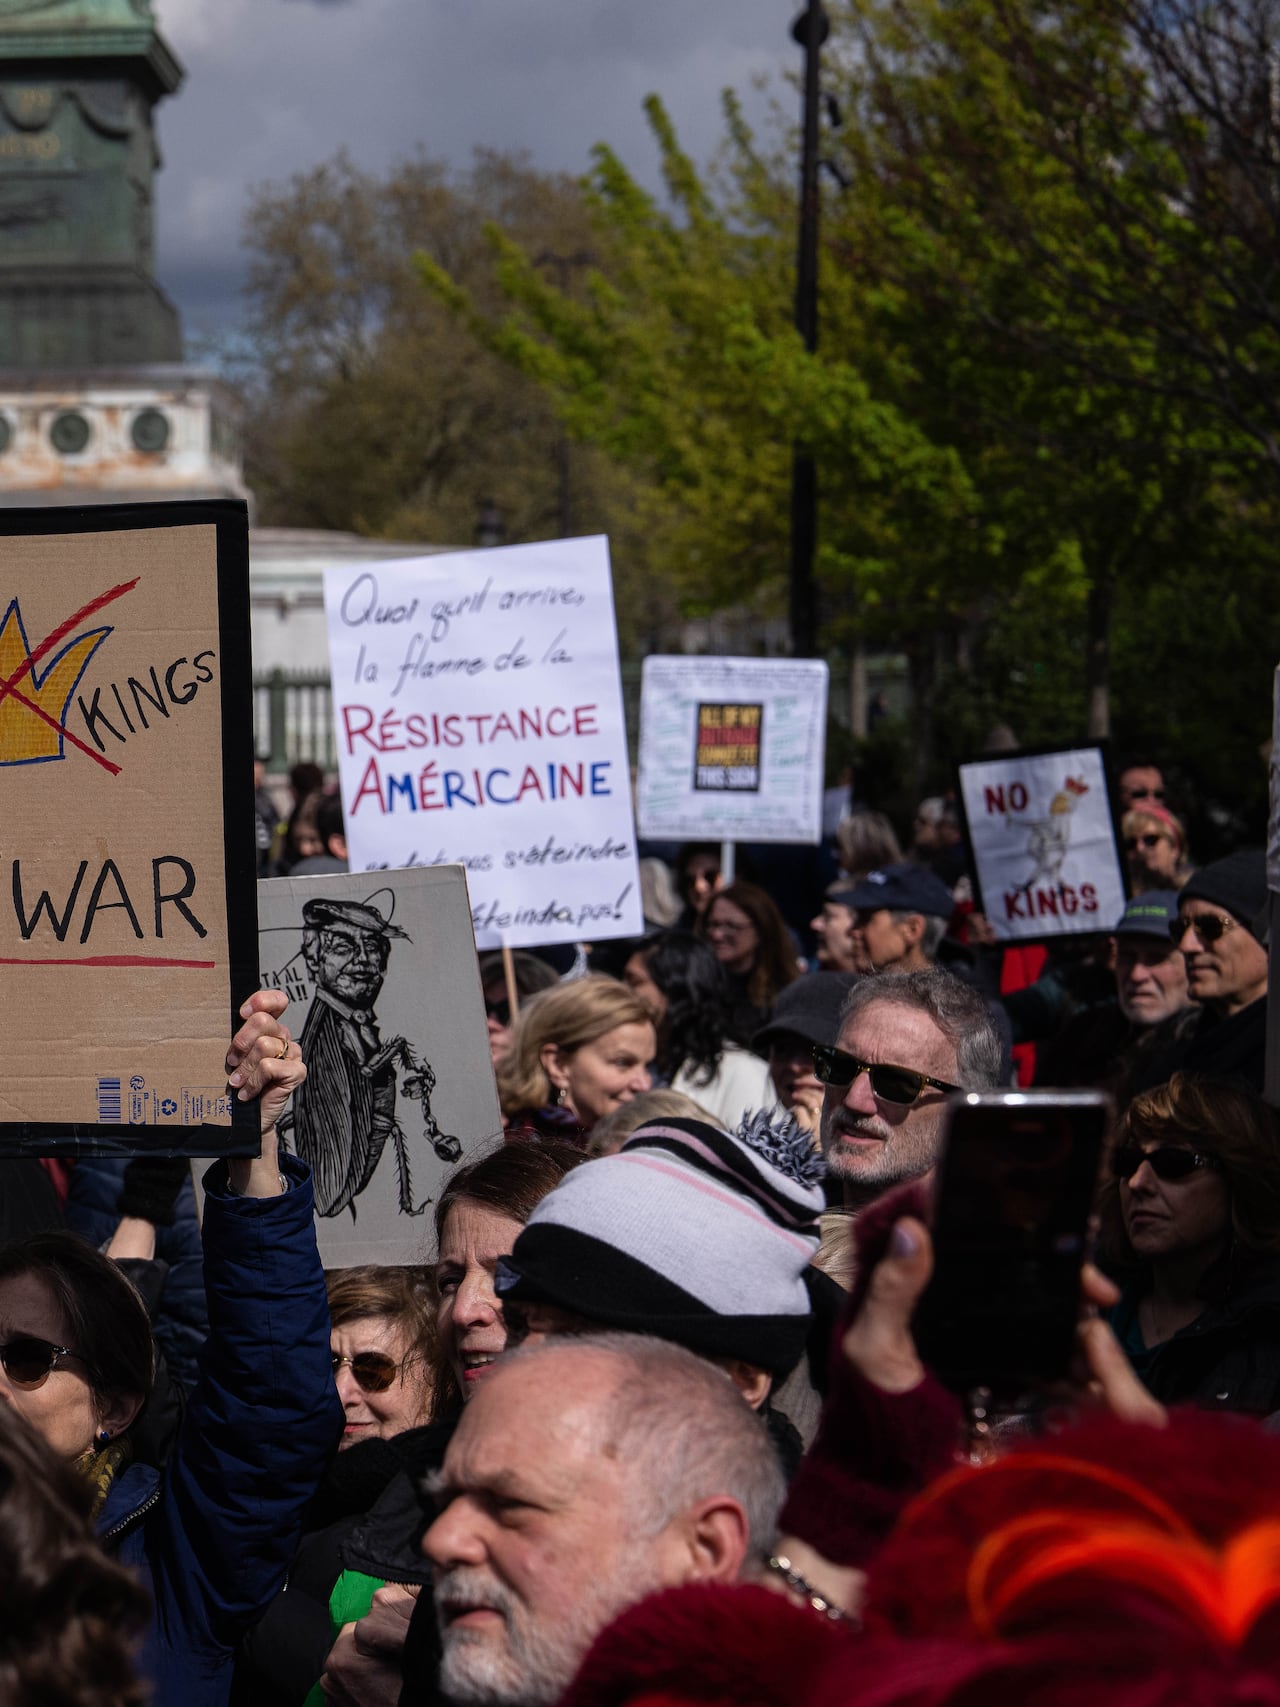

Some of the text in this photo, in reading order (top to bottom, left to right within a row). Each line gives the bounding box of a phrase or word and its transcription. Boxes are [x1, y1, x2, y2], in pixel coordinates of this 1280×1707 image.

[354, 627, 574, 697] la flamme de la
[77, 650, 216, 752] KINGS
[342, 704, 599, 755] RÉSISTANCE
[349, 756, 612, 817] AMÉRICAINE
[984, 782, 1029, 815] NO
[12, 855, 208, 944] WAR
[1003, 882, 1099, 920] KINGS
